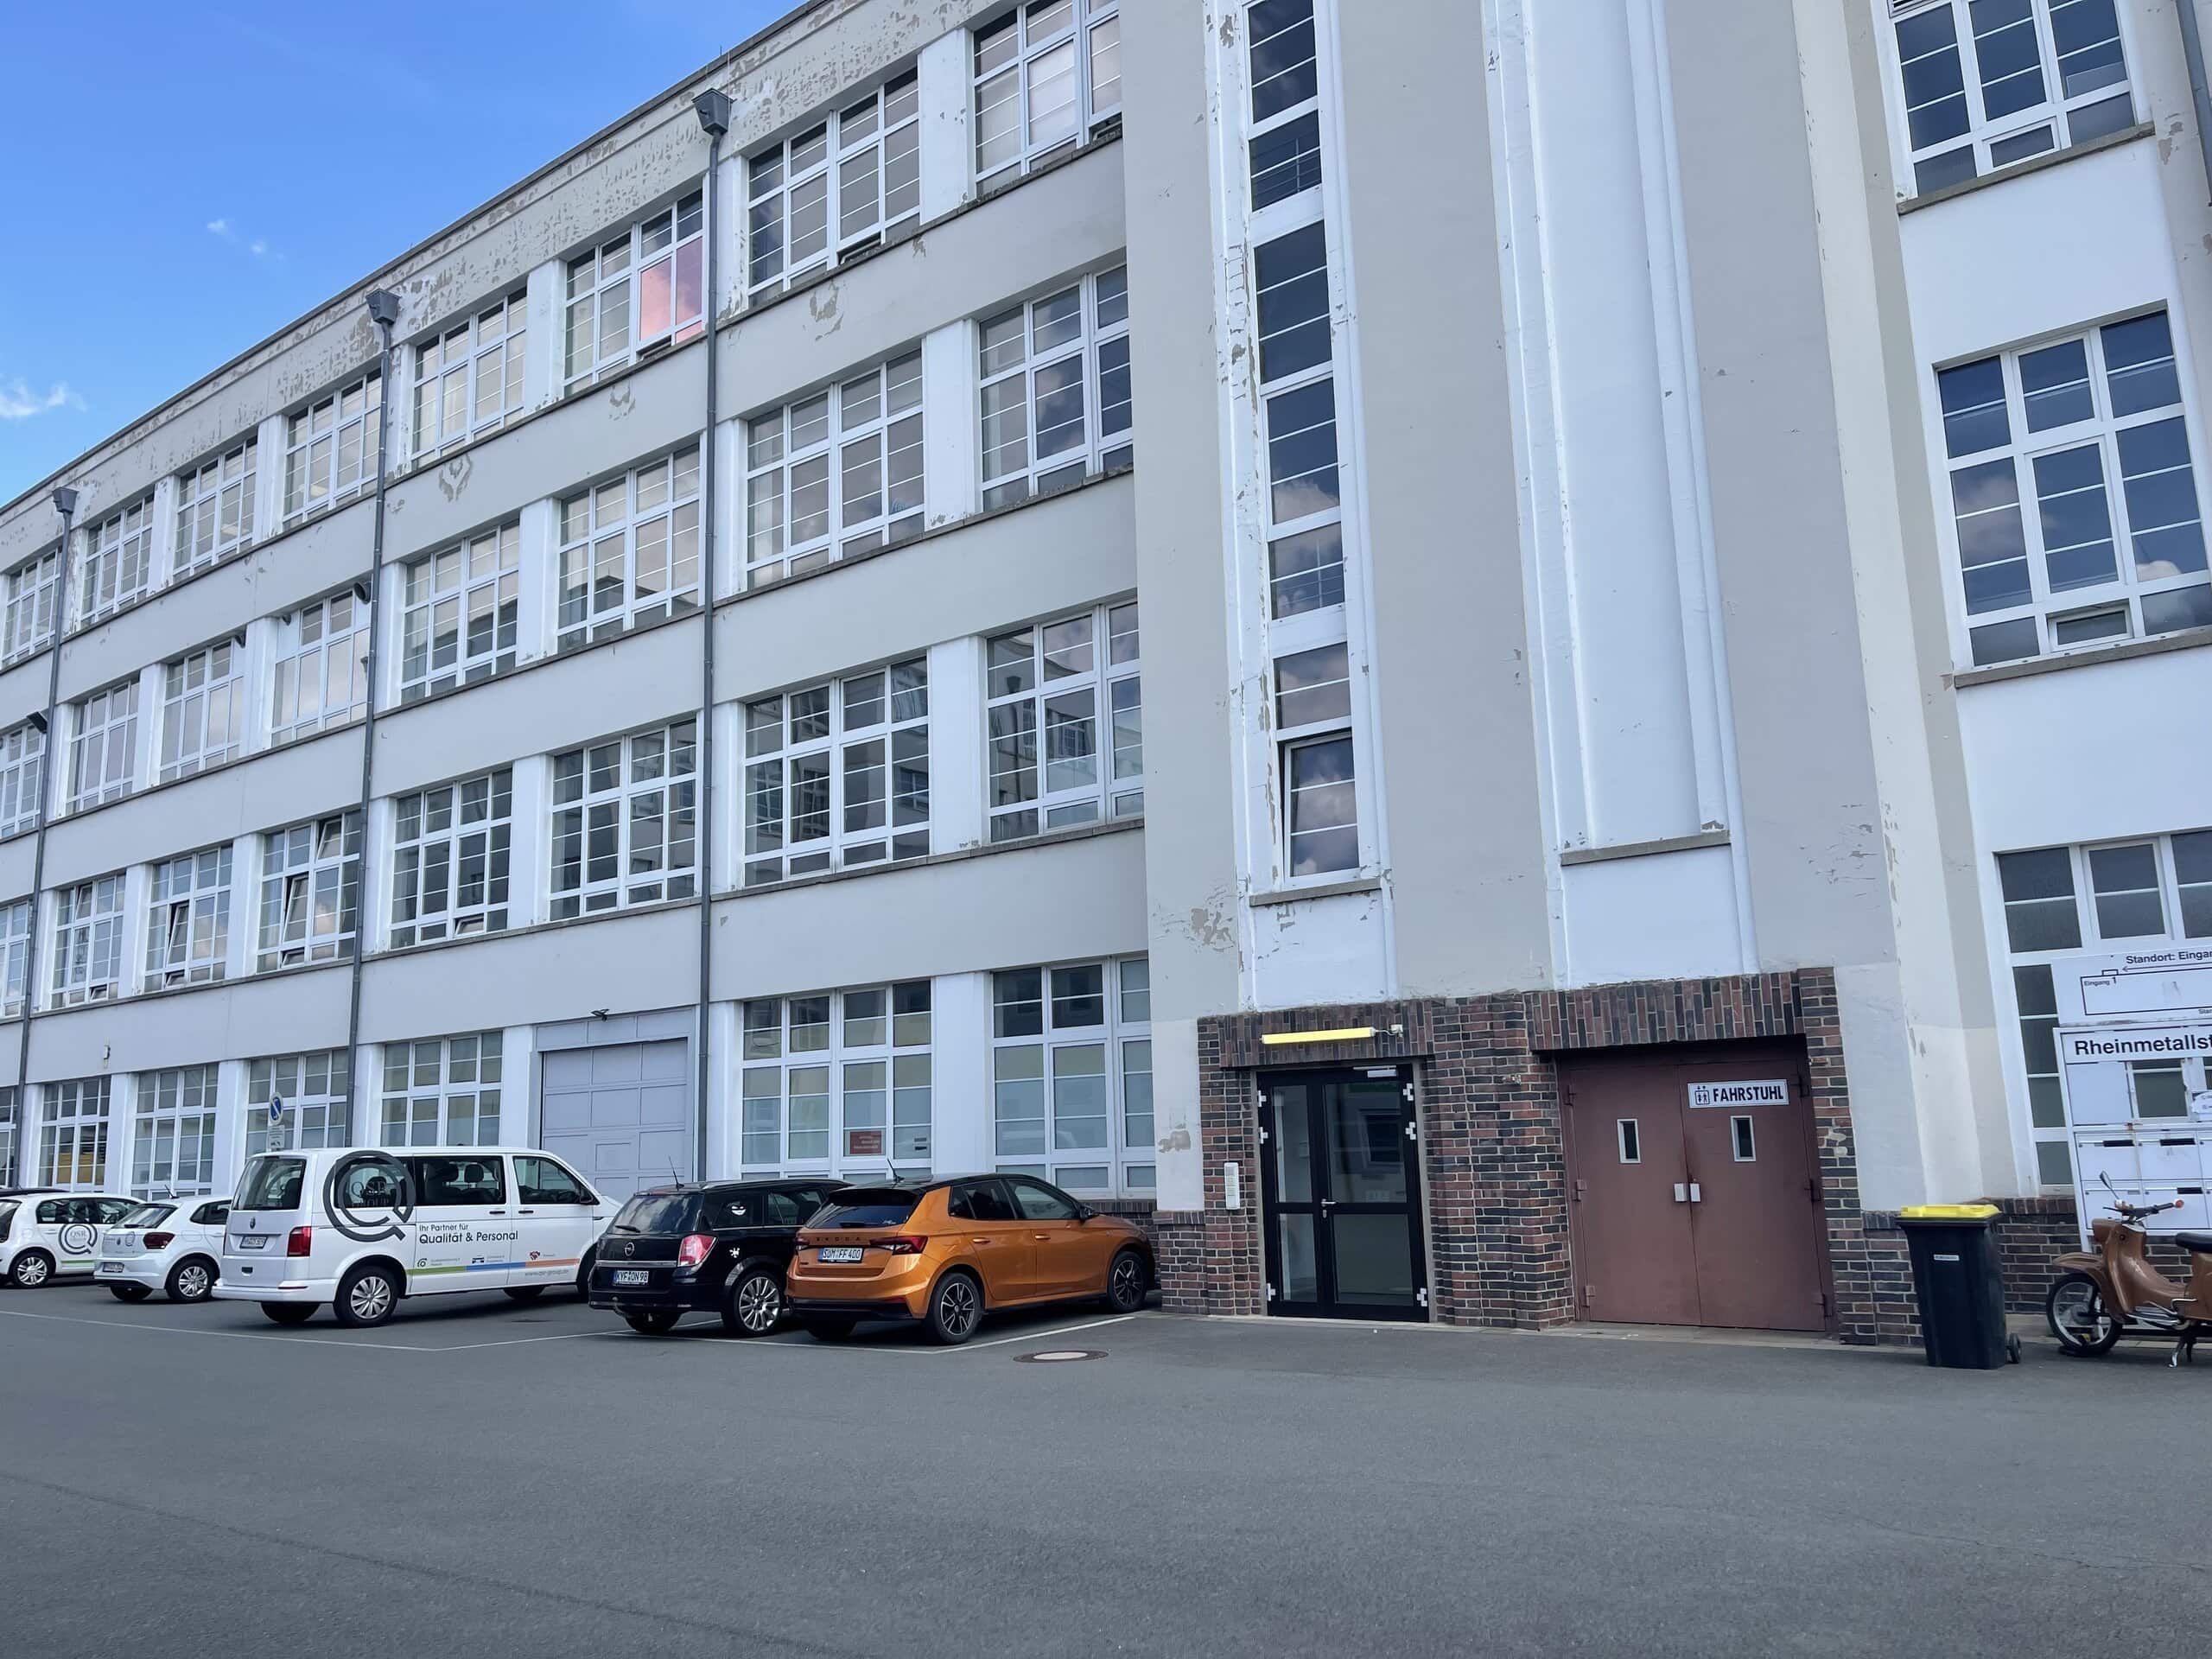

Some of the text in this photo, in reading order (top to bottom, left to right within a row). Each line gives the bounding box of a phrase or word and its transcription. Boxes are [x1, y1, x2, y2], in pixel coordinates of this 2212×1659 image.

[2126, 952, 2176, 964] Standort:
[1713, 1085, 1783, 1103] FAHRSTUHL
[419, 1230, 518, 1244] Qualität & Personal
